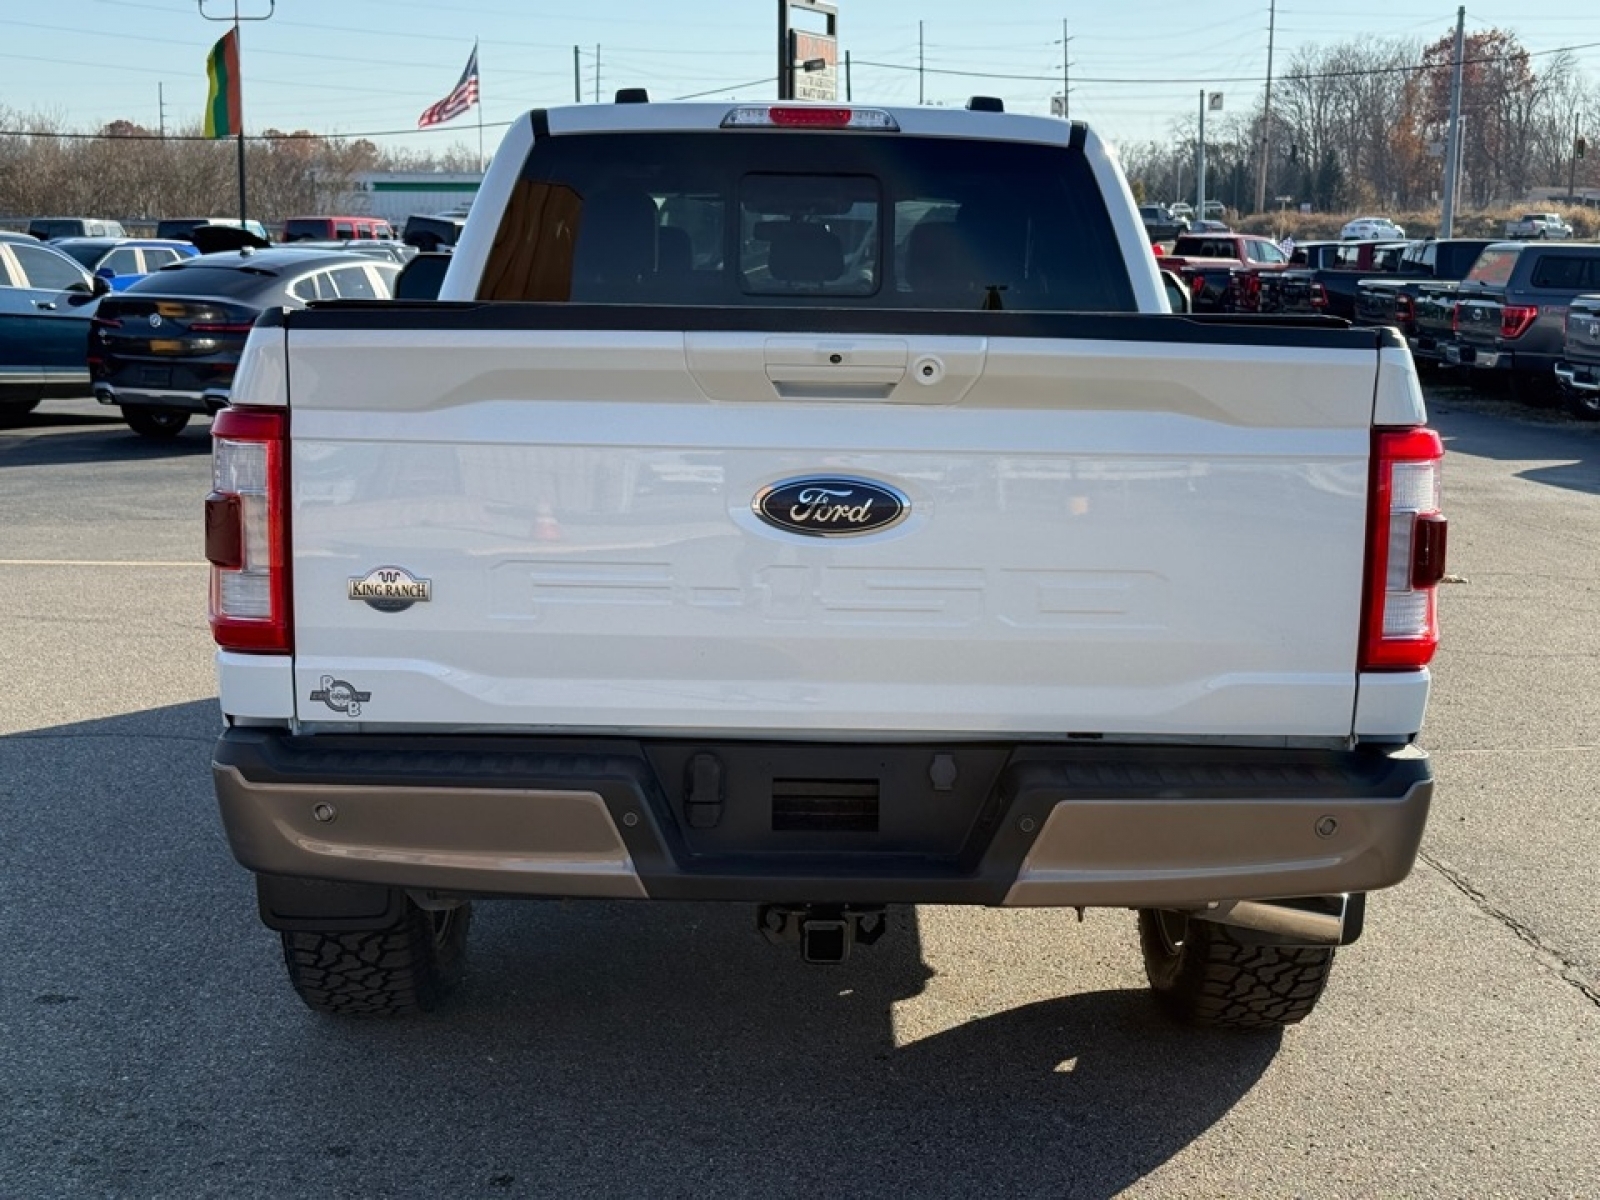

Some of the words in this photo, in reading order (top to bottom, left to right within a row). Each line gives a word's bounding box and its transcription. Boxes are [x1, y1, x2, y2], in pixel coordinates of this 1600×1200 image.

[789, 487, 874, 523] Ford
[352, 581, 383, 597] KING
[386, 584, 427, 598] RANCH
